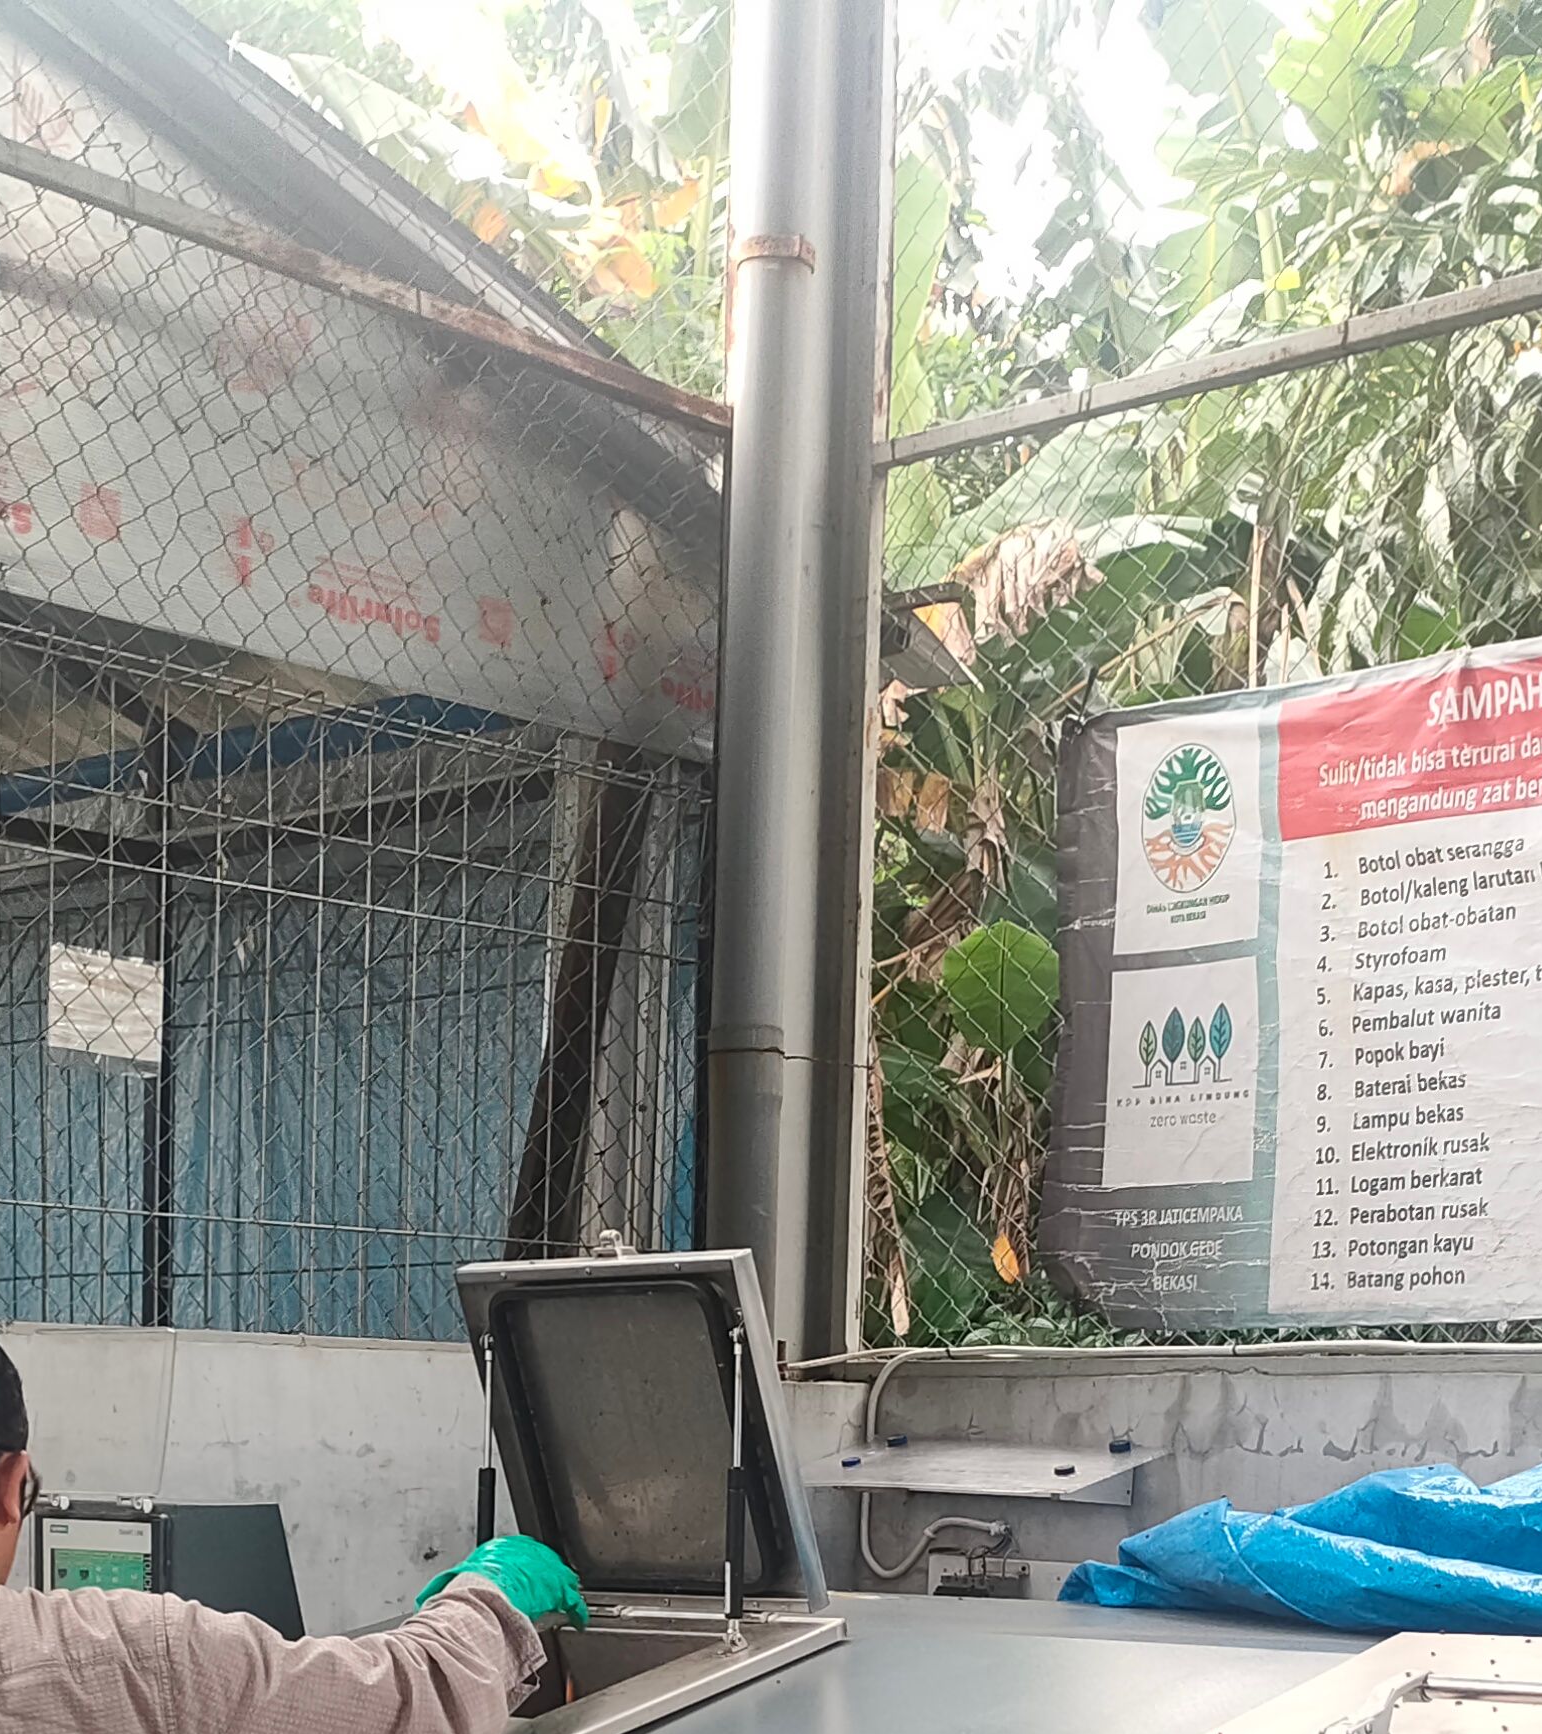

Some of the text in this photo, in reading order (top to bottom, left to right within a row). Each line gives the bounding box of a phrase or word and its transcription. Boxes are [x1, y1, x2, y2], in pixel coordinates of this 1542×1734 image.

[1319, 755, 1407, 788] Sulit/tidak
[1411, 746, 1446, 775] bisa
[1450, 734, 1516, 768] terurai
[1359, 787, 1478, 821] mengandung
[1482, 779, 1511, 803] zat
[1324, 836, 1525, 880] 1. Botol obat serangga
[1321, 892, 1337, 910] 2.
[1360, 874, 1469, 907] Botol/kaleng
[1473, 865, 1536, 892] larutan
[1319, 903, 1517, 942] 3. Botol obat-obatan
[1317, 945, 1447, 972] 4. Styrofoam
[1316, 987, 1331, 1005] 5.
[1353, 980, 1408, 1003] Kapas,
[1415, 975, 1458, 996] kasa,
[1465, 968, 1530, 994] plester,
[1318, 1002, 1501, 1037] 6. Pembalut wanita
[1318, 1037, 1444, 1069] 7. Popok bayi
[1317, 1070, 1466, 1101] 8. Baterai bekas
[1151, 1111, 1216, 1127] zero waste
[1316, 1103, 1464, 1134] 9. Lampu bekas
[1316, 1132, 1490, 1165] 10. Elektronik rusak
[1316, 1167, 1482, 1196] 11. Logam berkarat
[1115, 1211, 1137, 1226] TPS
[1159, 1206, 1243, 1224] JATICEMPAKA
[1313, 1198, 1489, 1228] 12. Perabotan rusak
[1131, 1239, 1224, 1258] PONDOK GEDE
[1311, 1233, 1473, 1260] 13. Potongan kayu
[1153, 1274, 1197, 1290] BEKASI
[1311, 1266, 1464, 1291] 14. Batang pohon
